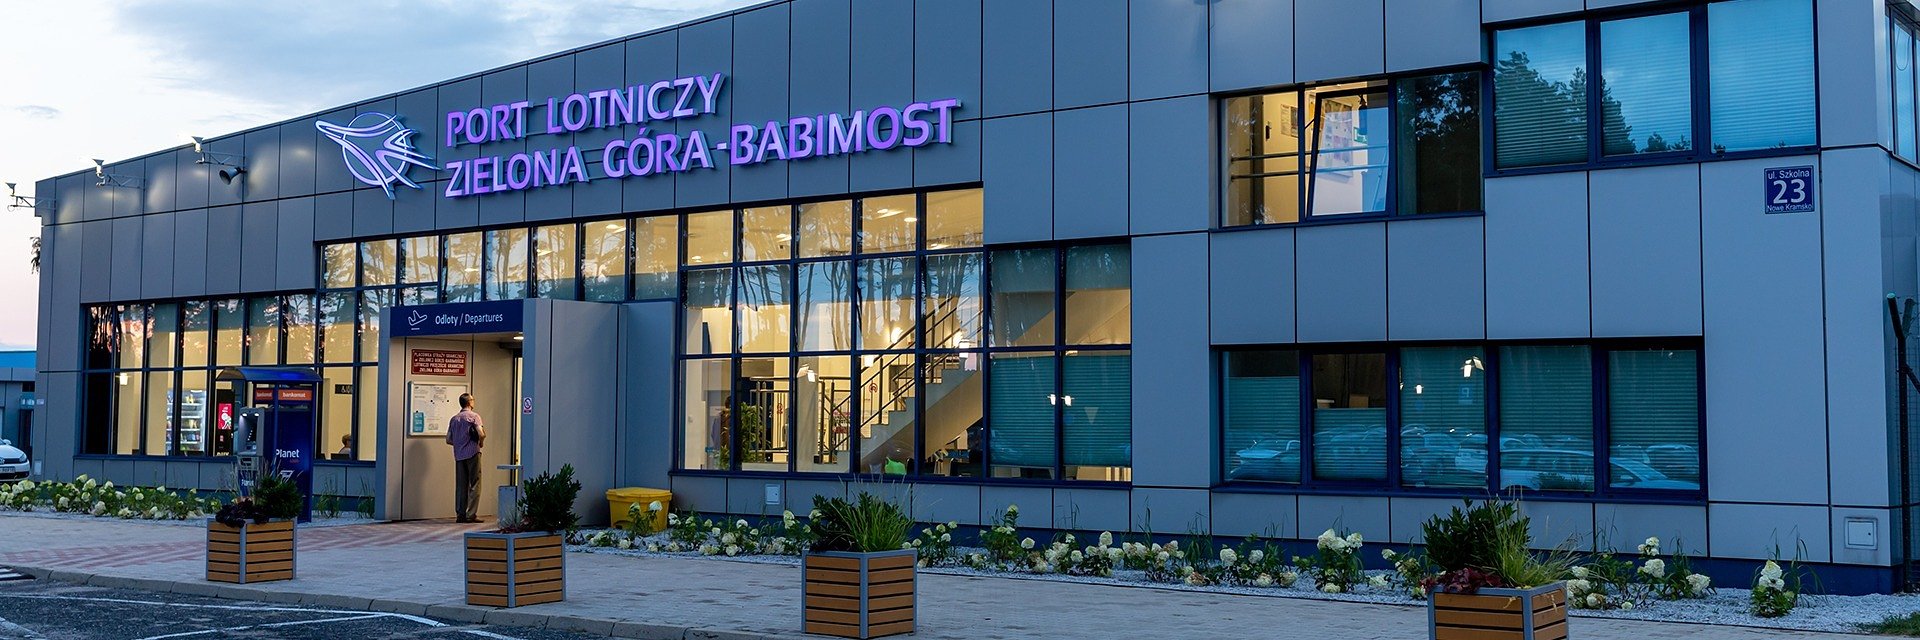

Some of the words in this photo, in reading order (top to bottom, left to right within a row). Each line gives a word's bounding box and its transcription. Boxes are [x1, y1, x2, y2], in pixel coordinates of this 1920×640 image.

[445, 101, 531, 147] PORT
[547, 72, 723, 134] LOTNICZY
[445, 146, 589, 198] ZIELONA
[1768, 171, 1778, 179] ul.
[1779, 170, 1810, 179] Szkolna
[1773, 178, 1806, 204] 23
[1785, 203, 1812, 211] Kramsko
[435, 314, 458, 326] Odloty
[464, 313, 503, 325] Departures
[275, 448, 300, 458] Planet
